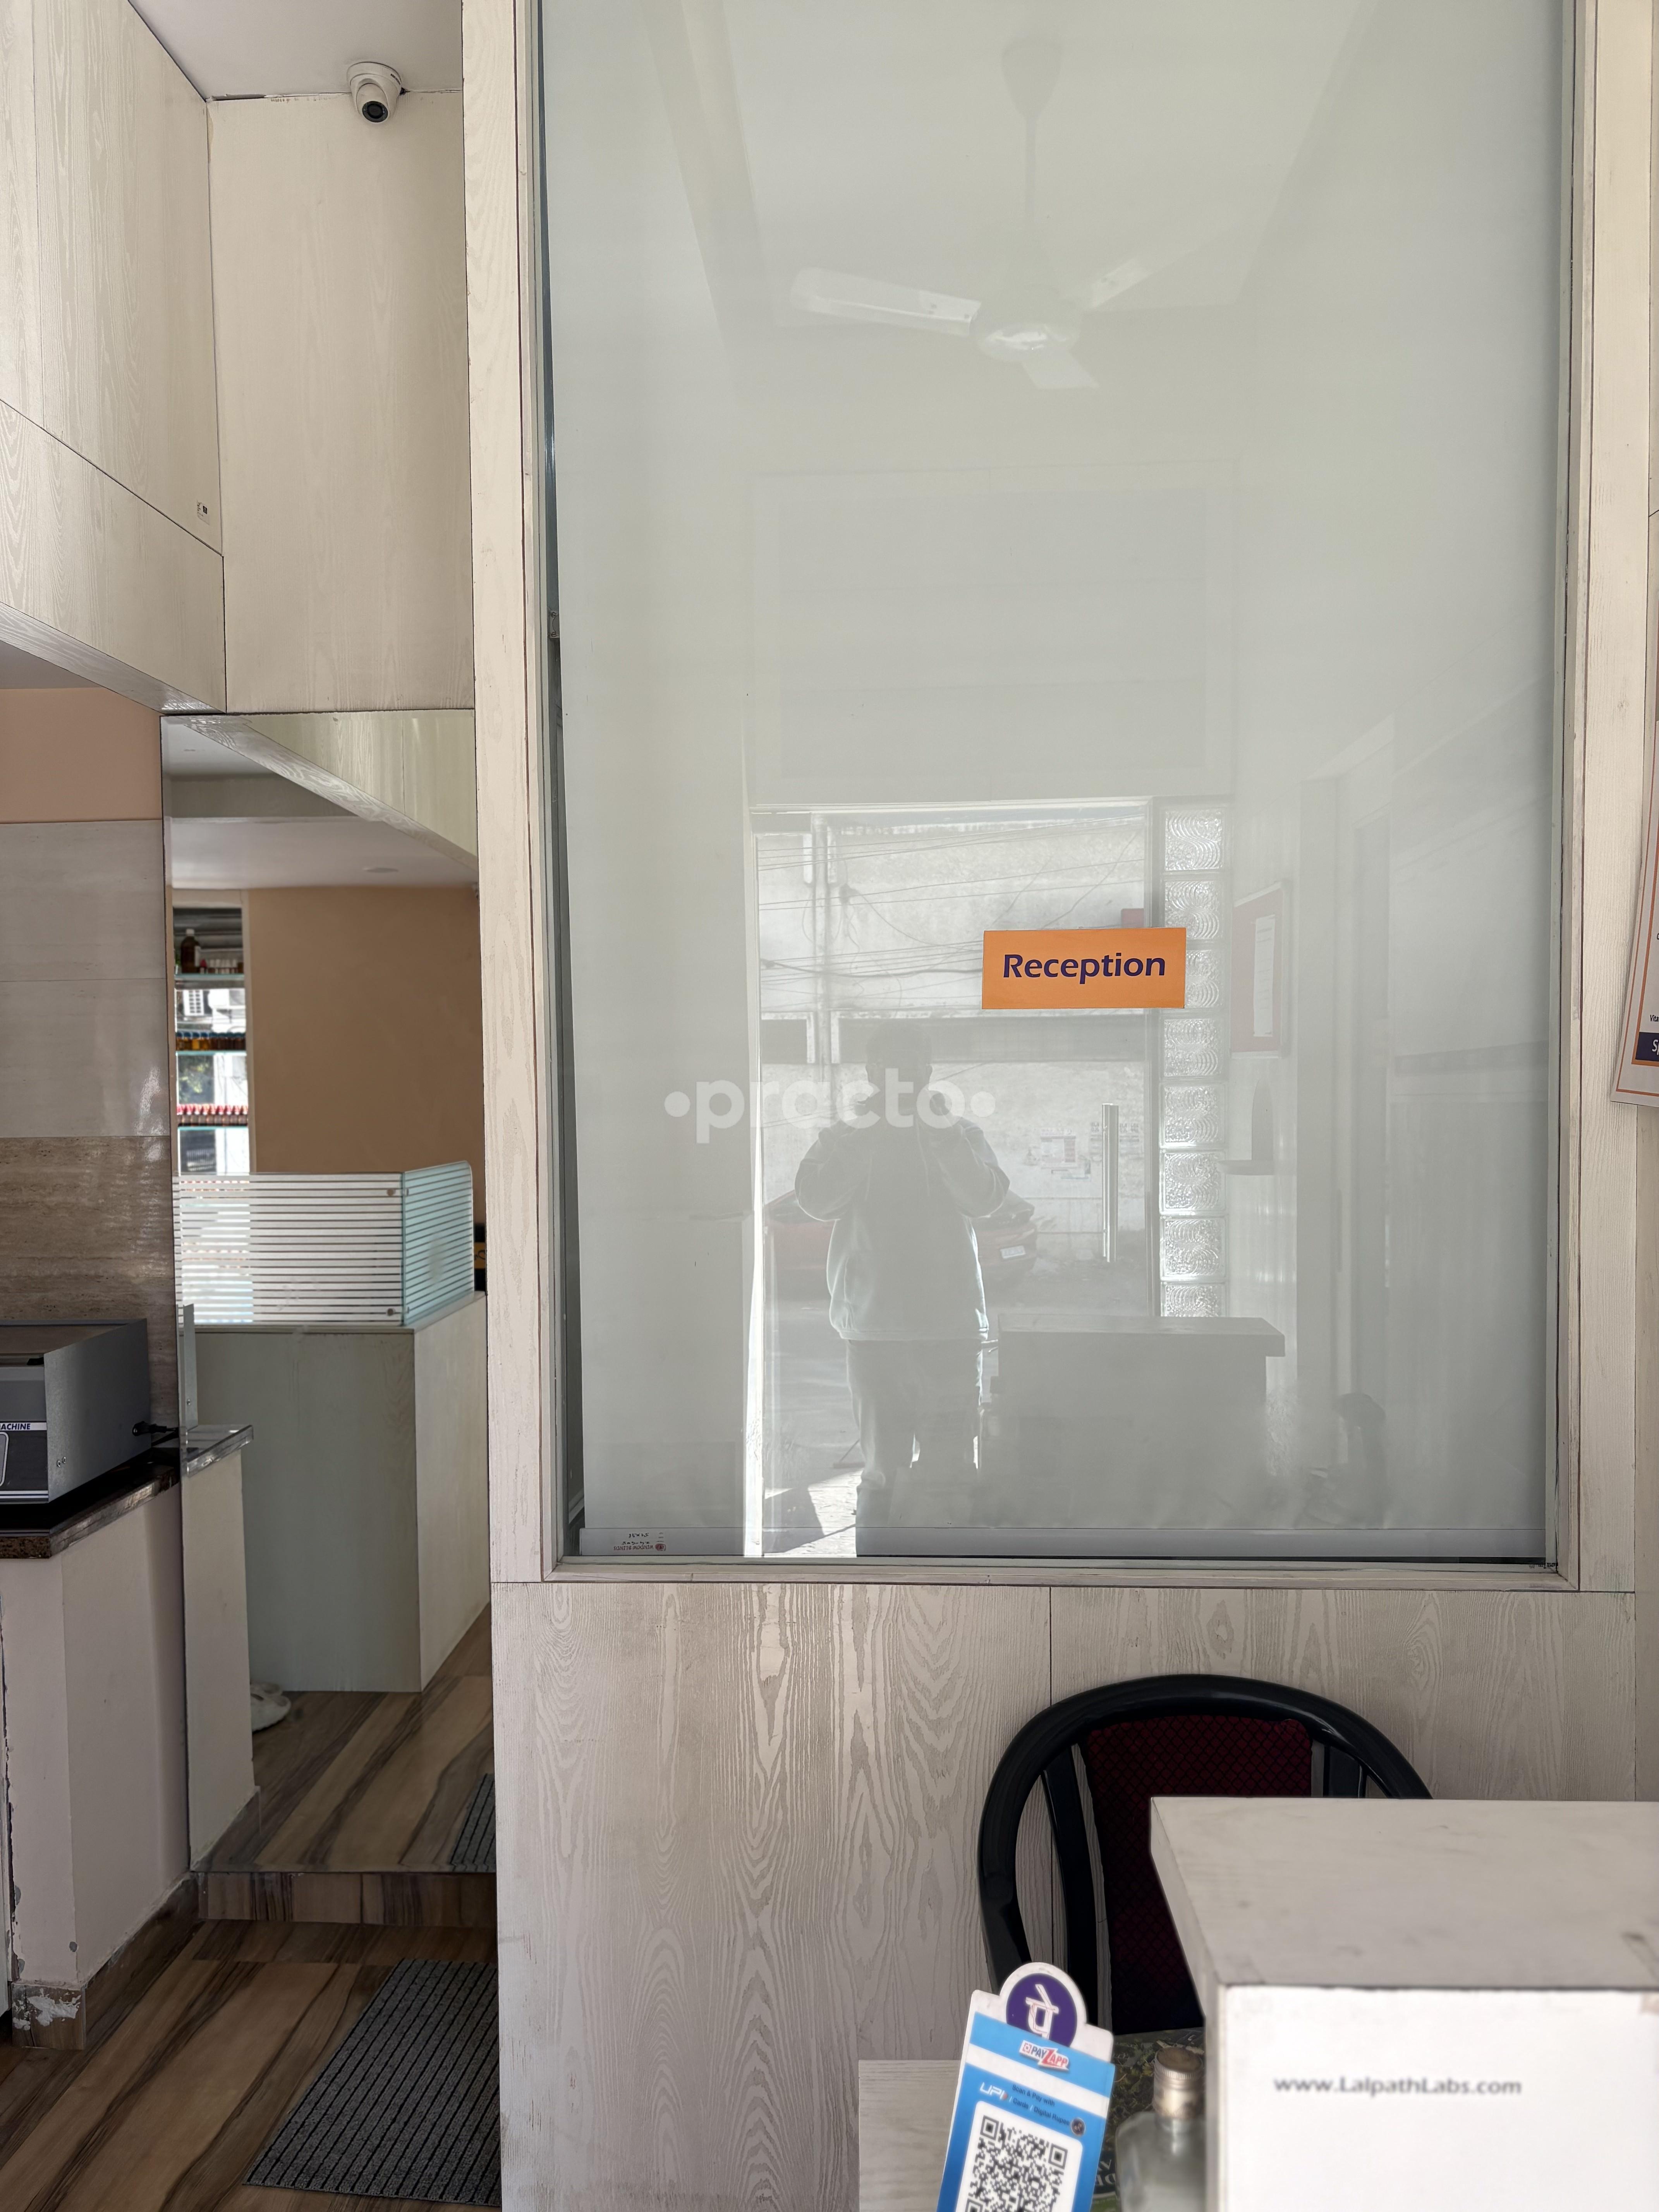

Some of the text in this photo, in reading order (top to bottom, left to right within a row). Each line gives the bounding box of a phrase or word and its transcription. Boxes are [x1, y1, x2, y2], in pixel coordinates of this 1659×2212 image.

[1003, 953, 1165, 984] Reception
[1012, 2084, 1025, 2095] Scan
[1032, 2092, 1042, 2102] Pay
[1043, 2097, 1055, 2107] with
[1273, 2077, 1522, 2097] www.LalpathLabs.com
[979, 2082, 1005, 2100] UPI
[1013, 2097, 1029, 2109] Cards
[1034, 2106, 1051, 2119] Digital
[1052, 2114, 1070, 2126] Rupee
